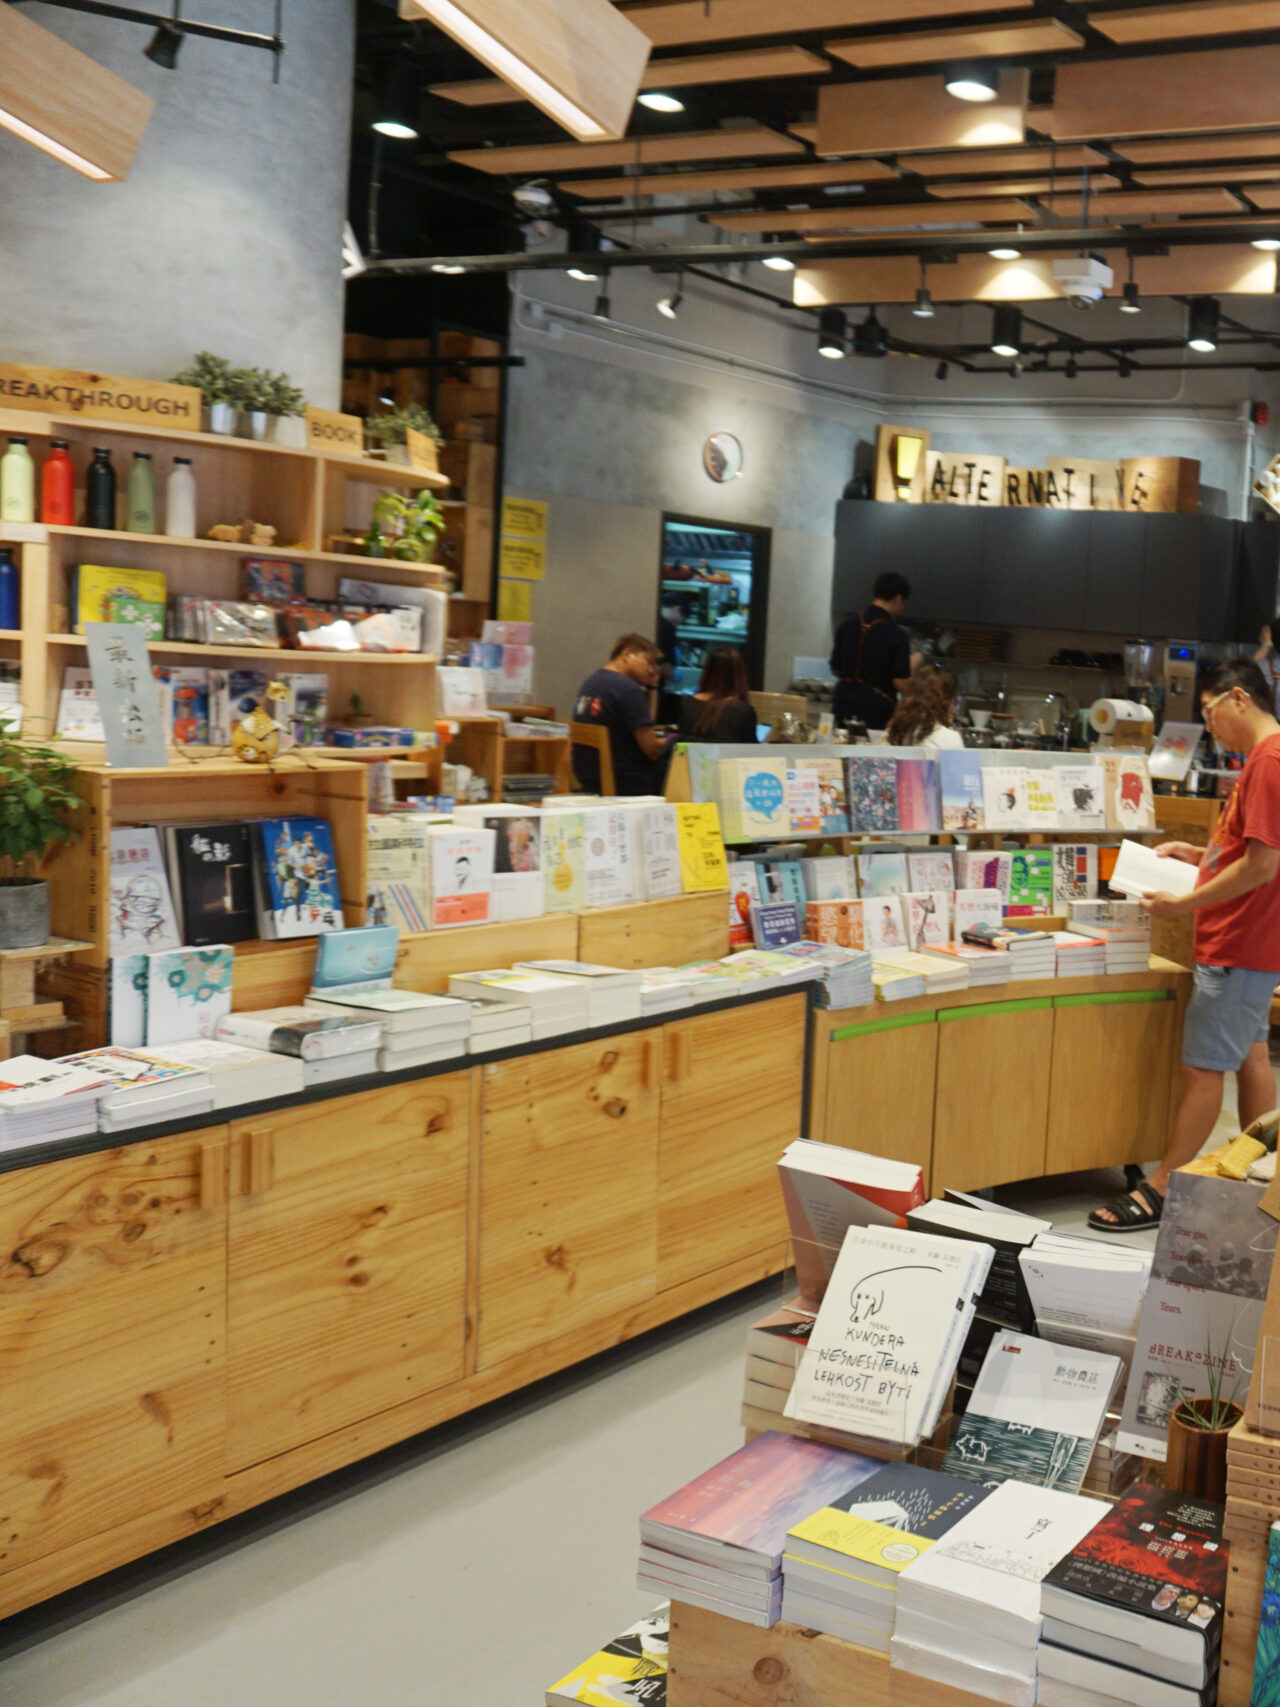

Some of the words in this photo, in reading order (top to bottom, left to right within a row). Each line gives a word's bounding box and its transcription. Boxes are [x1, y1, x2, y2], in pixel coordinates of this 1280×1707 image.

[311, 421, 357, 443] BOOK
[931, 459, 1149, 507] ALTERNATIVE
[1175, 1226, 1194, 1238] Tear
[1160, 1302, 1183, 1314] Tears.
[814, 1370, 873, 1393] LEHKOST
